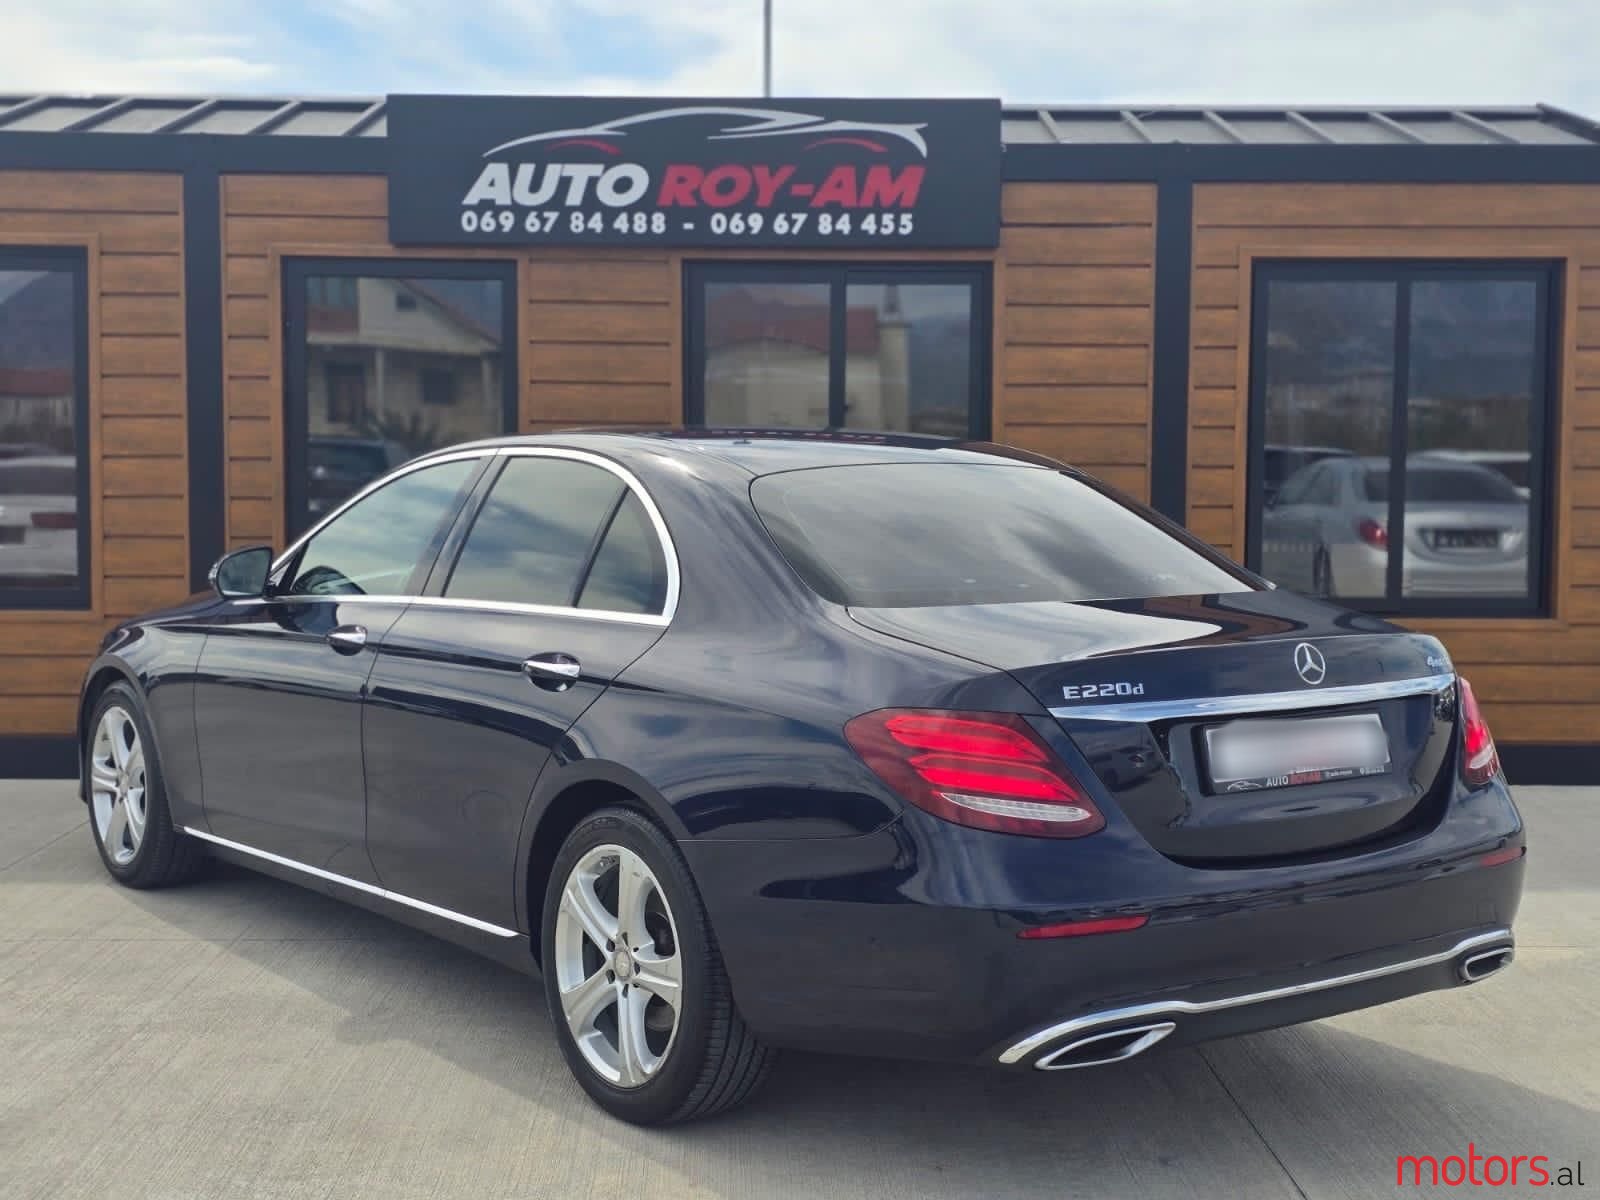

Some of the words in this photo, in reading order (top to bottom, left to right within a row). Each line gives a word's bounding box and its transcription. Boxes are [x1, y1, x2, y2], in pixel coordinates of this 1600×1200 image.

[461, 162, 650, 207] AUTO
[656, 163, 926, 207] ROY-AM
[461, 210, 515, 233] 069
[525, 211, 560, 233] 67
[569, 211, 604, 234] 84
[613, 211, 667, 234] 488
[710, 212, 764, 235] 069
[773, 212, 808, 235] 67
[817, 213, 852, 235] 84
[860, 213, 914, 235] 455
[1062, 682, 1145, 700] E220d
[1266, 775, 1289, 788] AUTO
